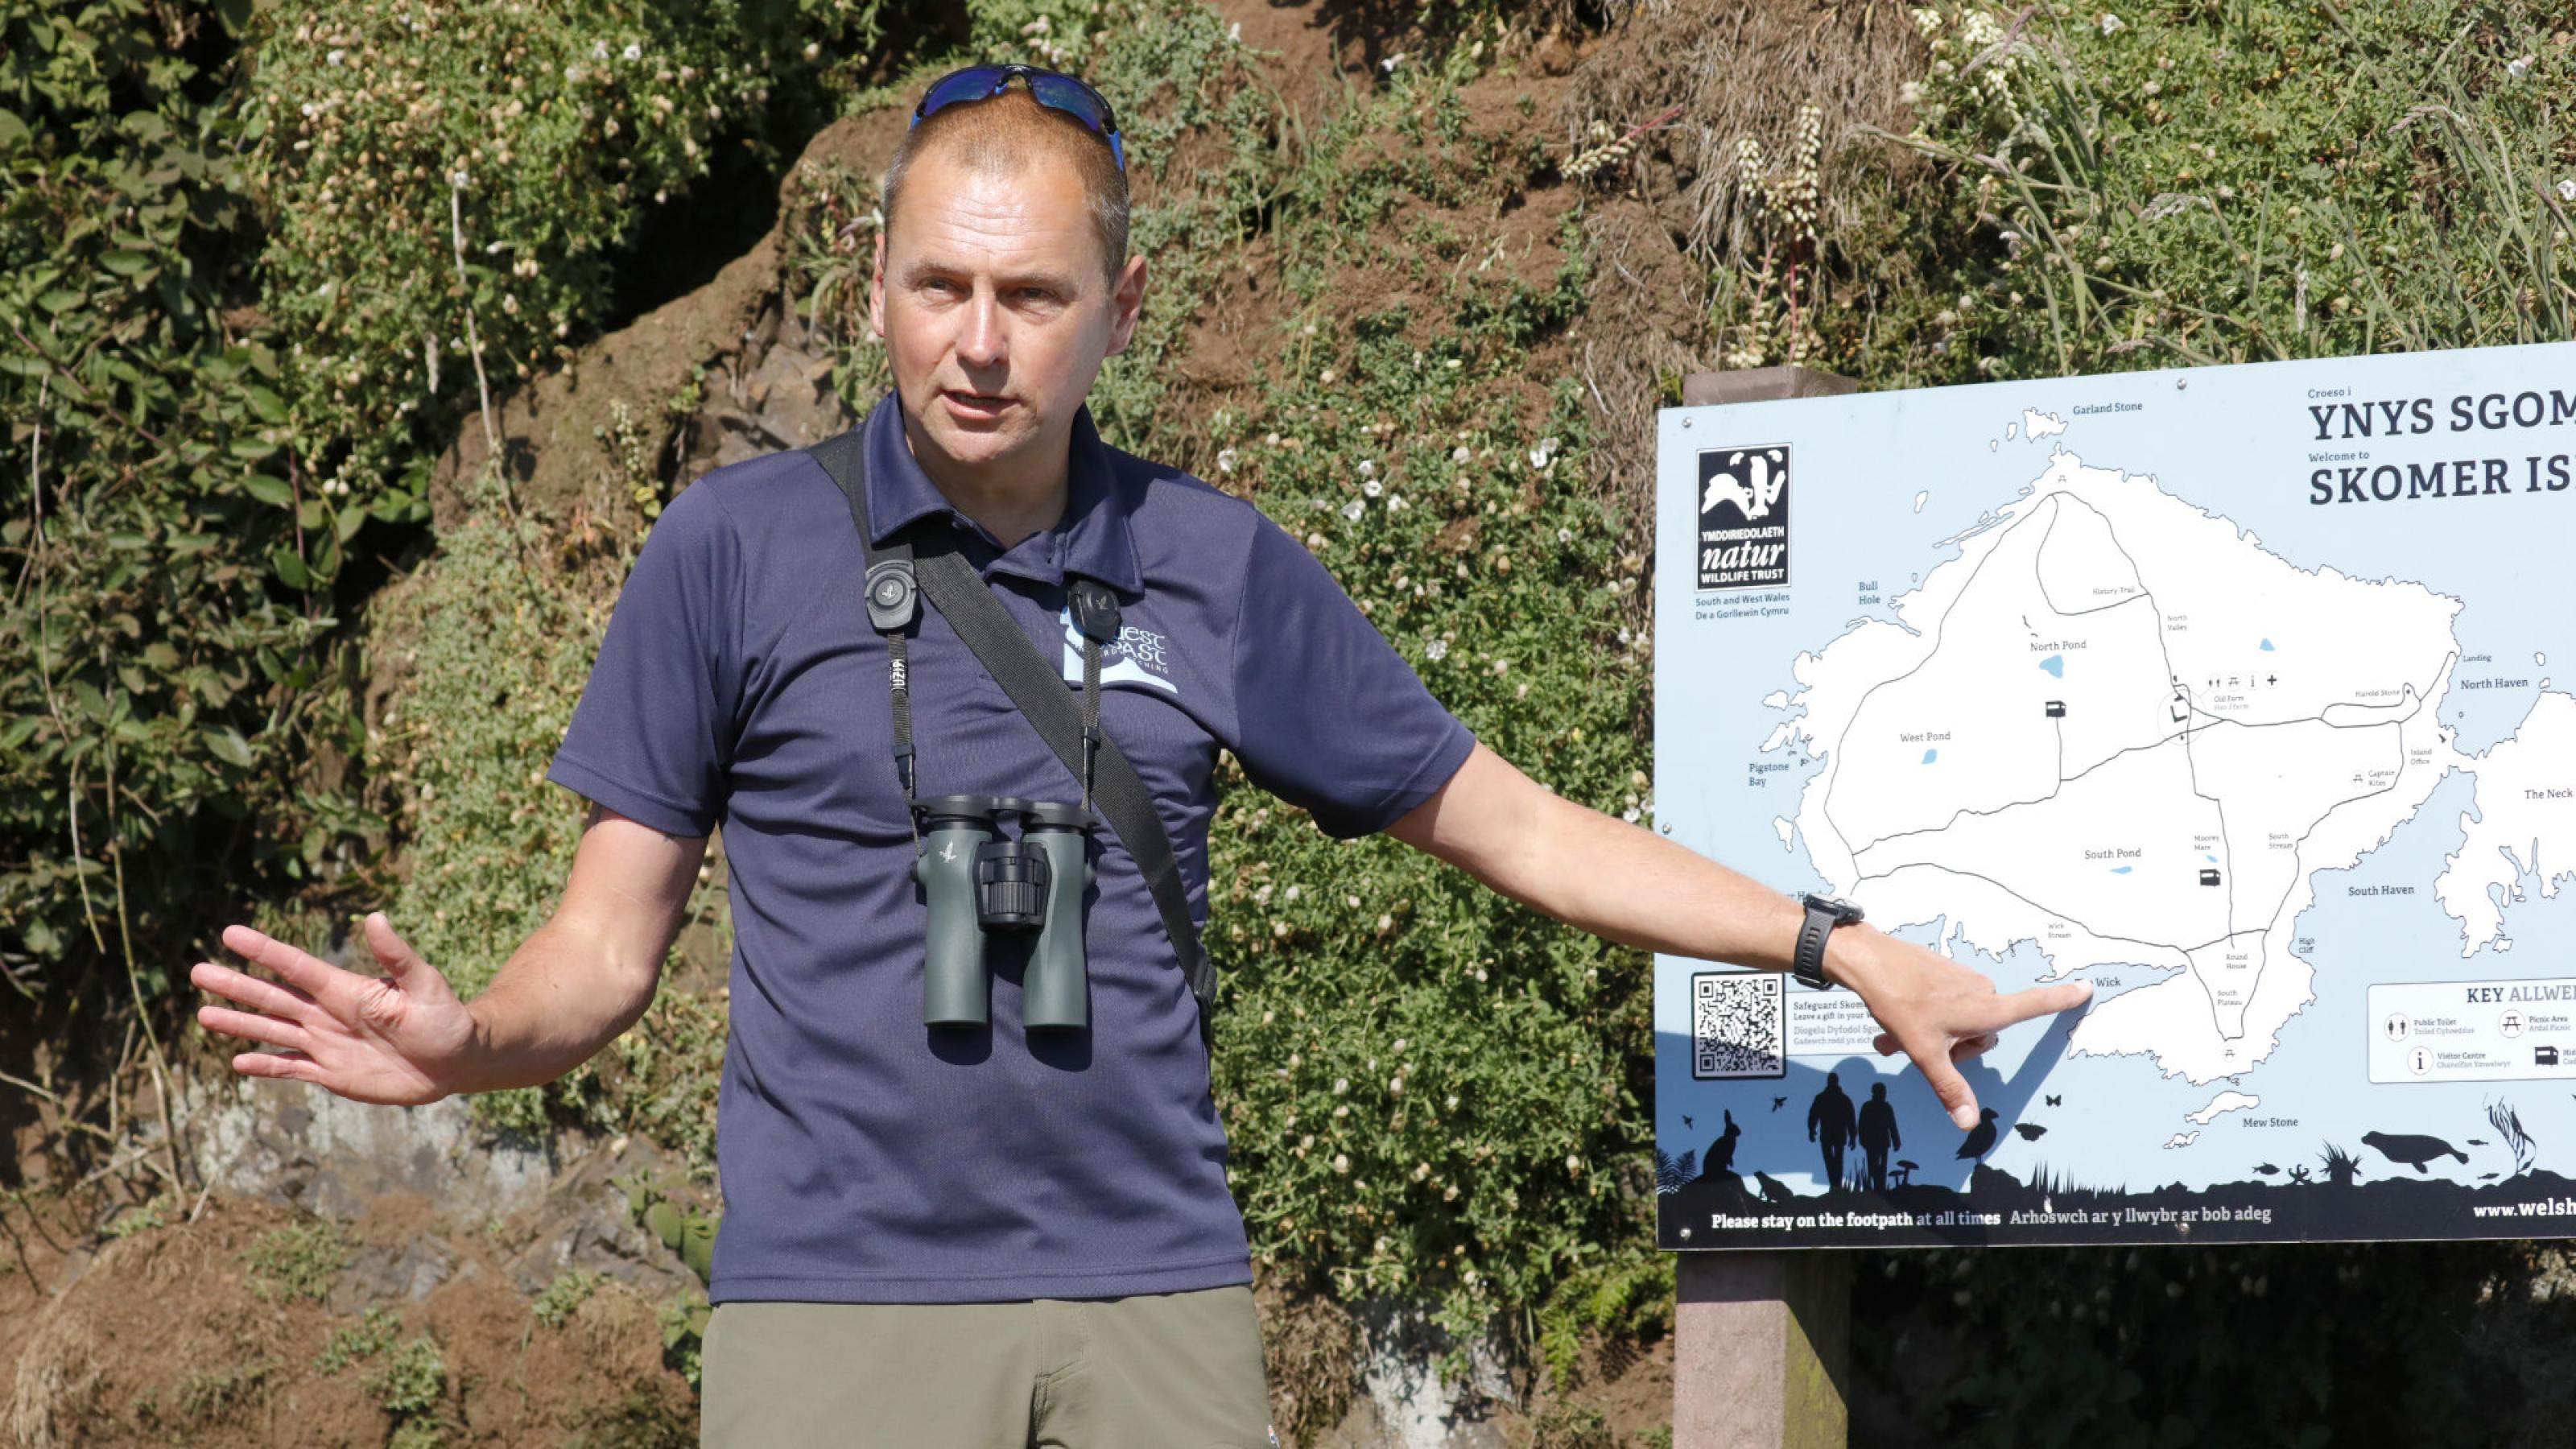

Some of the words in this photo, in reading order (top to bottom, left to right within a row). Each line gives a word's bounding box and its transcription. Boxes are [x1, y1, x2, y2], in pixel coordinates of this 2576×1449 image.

[2307, 387, 2345, 399] Croeso
[2347, 386, 2351, 396] i
[2073, 404, 2113, 416] Garland
[2114, 402, 2143, 412] Stone
[2308, 398, 2434, 440] YNYS
[2450, 390, 2576, 432] SGOM
[2309, 452, 2356, 463] Welcome
[2359, 451, 2370, 460] to
[2310, 459, 2512, 506] SKOMER
[2525, 454, 2576, 493] IS
[1702, 540, 1785, 571] natur
[1701, 570, 1750, 584] WILDLIFE
[1751, 568, 1785, 580] TRUST
[1859, 580, 1878, 591] Bull
[1695, 597, 1721, 606] South
[1723, 596, 1740, 605] and
[1742, 594, 1763, 603] West
[1765, 592, 1790, 601] Wales
[1859, 594, 1880, 605] Hole
[1695, 610, 1707, 620] De
[1761, 606, 1790, 617] Cymru
[2030, 641, 2060, 652] North
[2062, 638, 2087, 650] Pond
[2461, 679, 2492, 689] North
[2495, 678, 2529, 687] Haven
[1900, 733, 1924, 742] West
[1926, 730, 1951, 741] Pond
[1749, 762, 1790, 774] Pigstone
[1749, 777, 1766, 788] Bay
[2524, 789, 2545, 799] The
[2547, 787, 2574, 798] Neck
[2084, 849, 2115, 860] South
[2116, 847, 2142, 858] Pond
[2348, 886, 2379, 897] South
[2381, 885, 2415, 895] Haven
[2095, 976, 2121, 988] Wick
[2466, 987, 2505, 1003] KEY
[2508, 985, 2576, 1001] ALLWE
[1793, 1001, 1838, 1012] Safeguard
[1839, 1000, 1864, 1009] Skom
[1794, 1012, 1815, 1021] Leave
[1838, 1011, 1845, 1019] in
[1847, 1013, 1864, 1021] your
[2415, 1018, 2435, 1026] Public
[2437, 1017, 2457, 1026] Toilet
[2529, 1014, 2550, 1023] Picnic
[2551, 1014, 2569, 1022] Area
[2438, 1052, 2461, 1060] Visitor
[2462, 1051, 2487, 1059] Centre
[2243, 1117, 2268, 1128] Mew
[2269, 1117, 2299, 1127] Stone
[1711, 1214, 1759, 1228] Please
[1761, 1214, 1794, 1231] stay
[1796, 1216, 1816, 1228] on
[1818, 1213, 1843, 1228] the
[1846, 1212, 1913, 1231] footpath
[1916, 1214, 1932, 1226] at
[1935, 1211, 1955, 1225] all
[1958, 1211, 2001, 1225] times
[2009, 1209, 2088, 1224] Arhoswch
[2091, 1212, 2108, 1223] ar
[2111, 1211, 2123, 1226] y
[2124, 1208, 2178, 1224] llwybr
[2181, 1210, 2198, 1222] ar
[2202, 1206, 2231, 1222] bob
[2234, 1206, 2272, 1224] adeg
